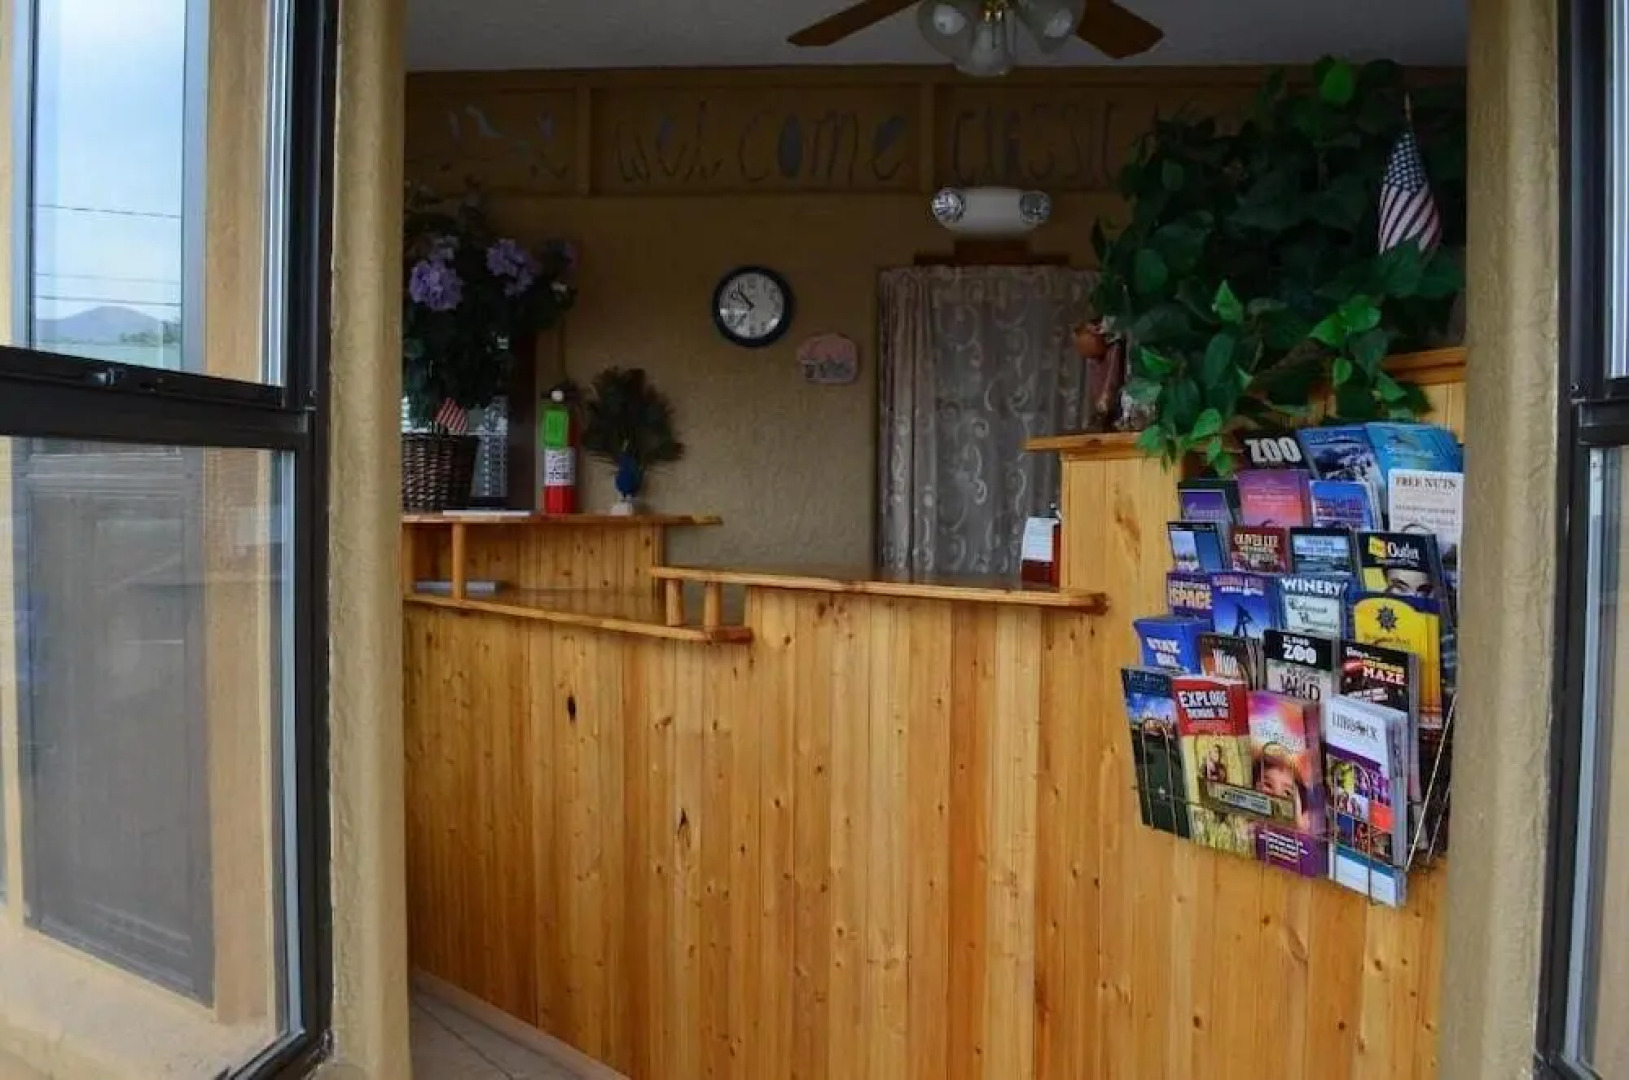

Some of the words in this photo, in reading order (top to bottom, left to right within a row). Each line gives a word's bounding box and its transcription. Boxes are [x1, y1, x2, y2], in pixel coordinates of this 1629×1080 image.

[1244, 436, 1302, 463] ZOO
[1394, 475, 1422, 488] FREE
[1424, 477, 1457, 490] NUTS
[1282, 643, 1317, 664] ZOO
[1362, 667, 1405, 685] MAZE
[1177, 690, 1229, 708] EXPLORE
